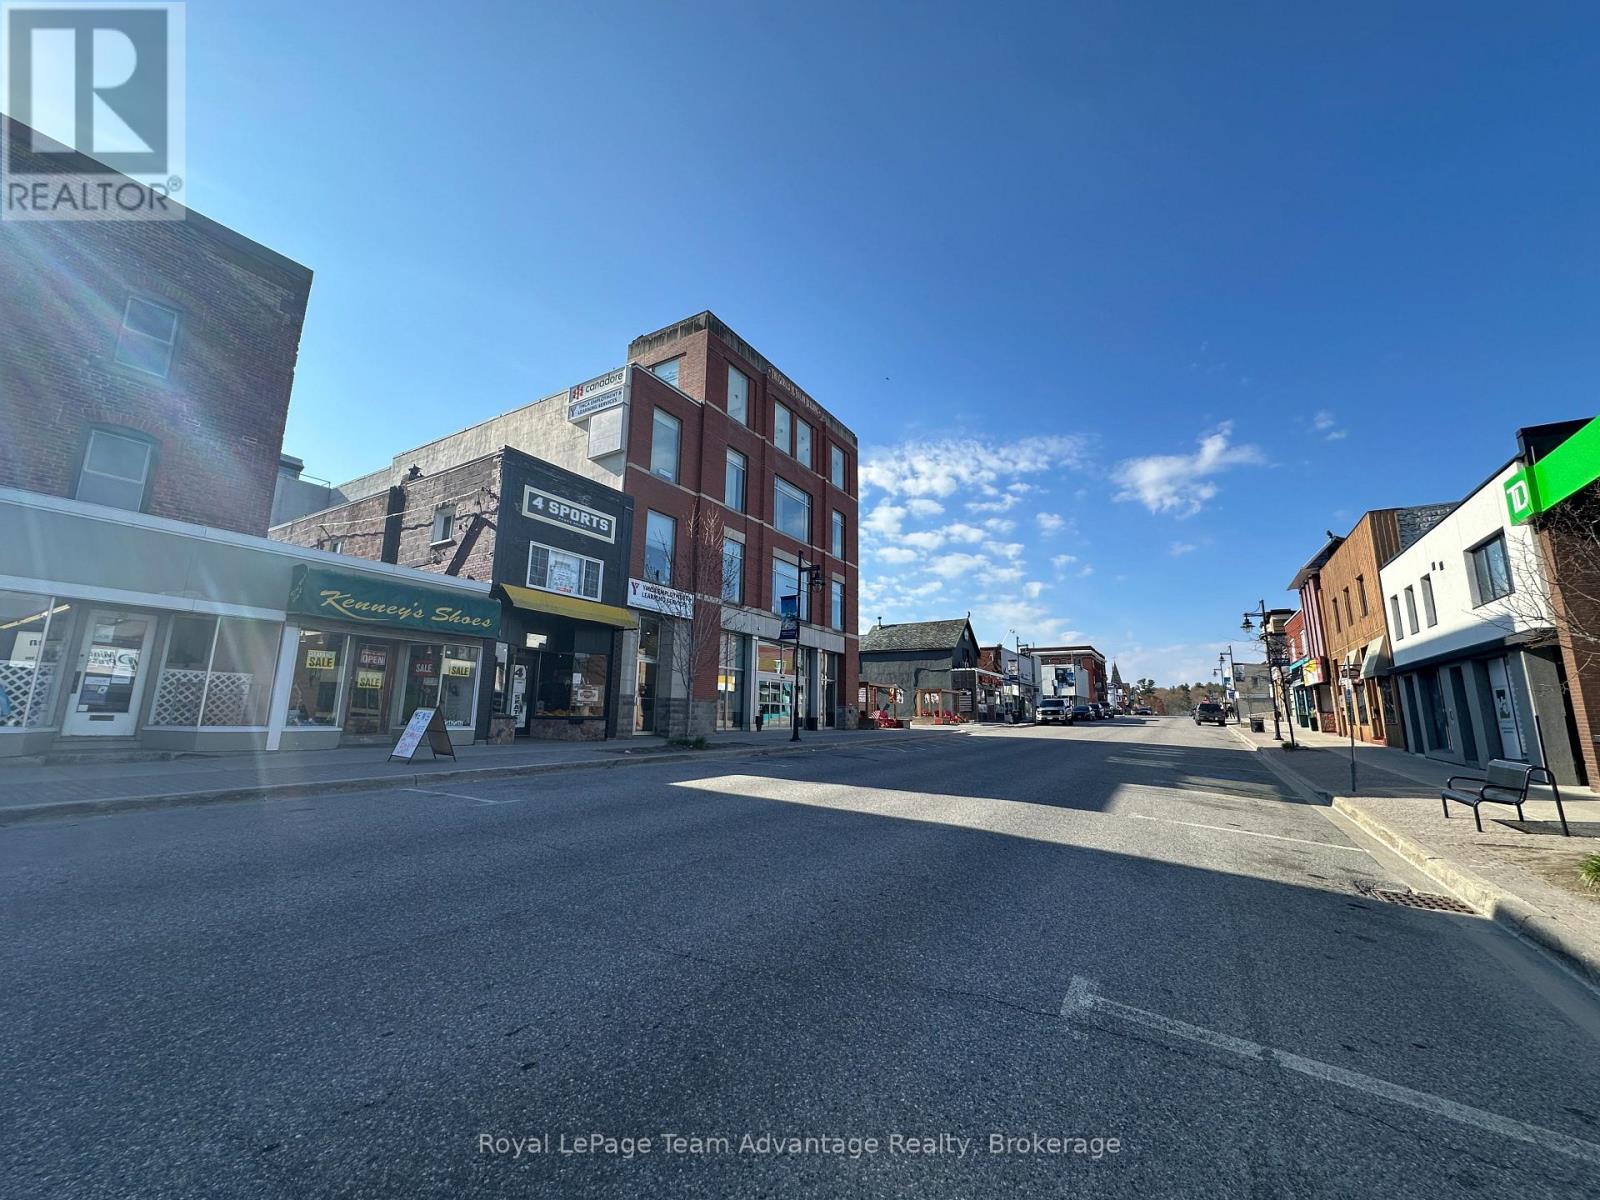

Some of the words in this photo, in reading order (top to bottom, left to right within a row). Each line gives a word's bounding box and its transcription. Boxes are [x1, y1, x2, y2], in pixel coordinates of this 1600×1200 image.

[585, 372, 623, 393] canadore
[1506, 480, 1529, 514] TD
[532, 497, 545, 510] 4
[548, 501, 609, 531] SPORTS
[320, 590, 424, 621] Kenney's
[432, 607, 492, 628] Shoes
[309, 657, 333, 668] SALE
[363, 655, 385, 666] OPEN
[416, 664, 432, 673] SALE
[451, 666, 469, 676] SALE
[360, 677, 380, 687] SALE
